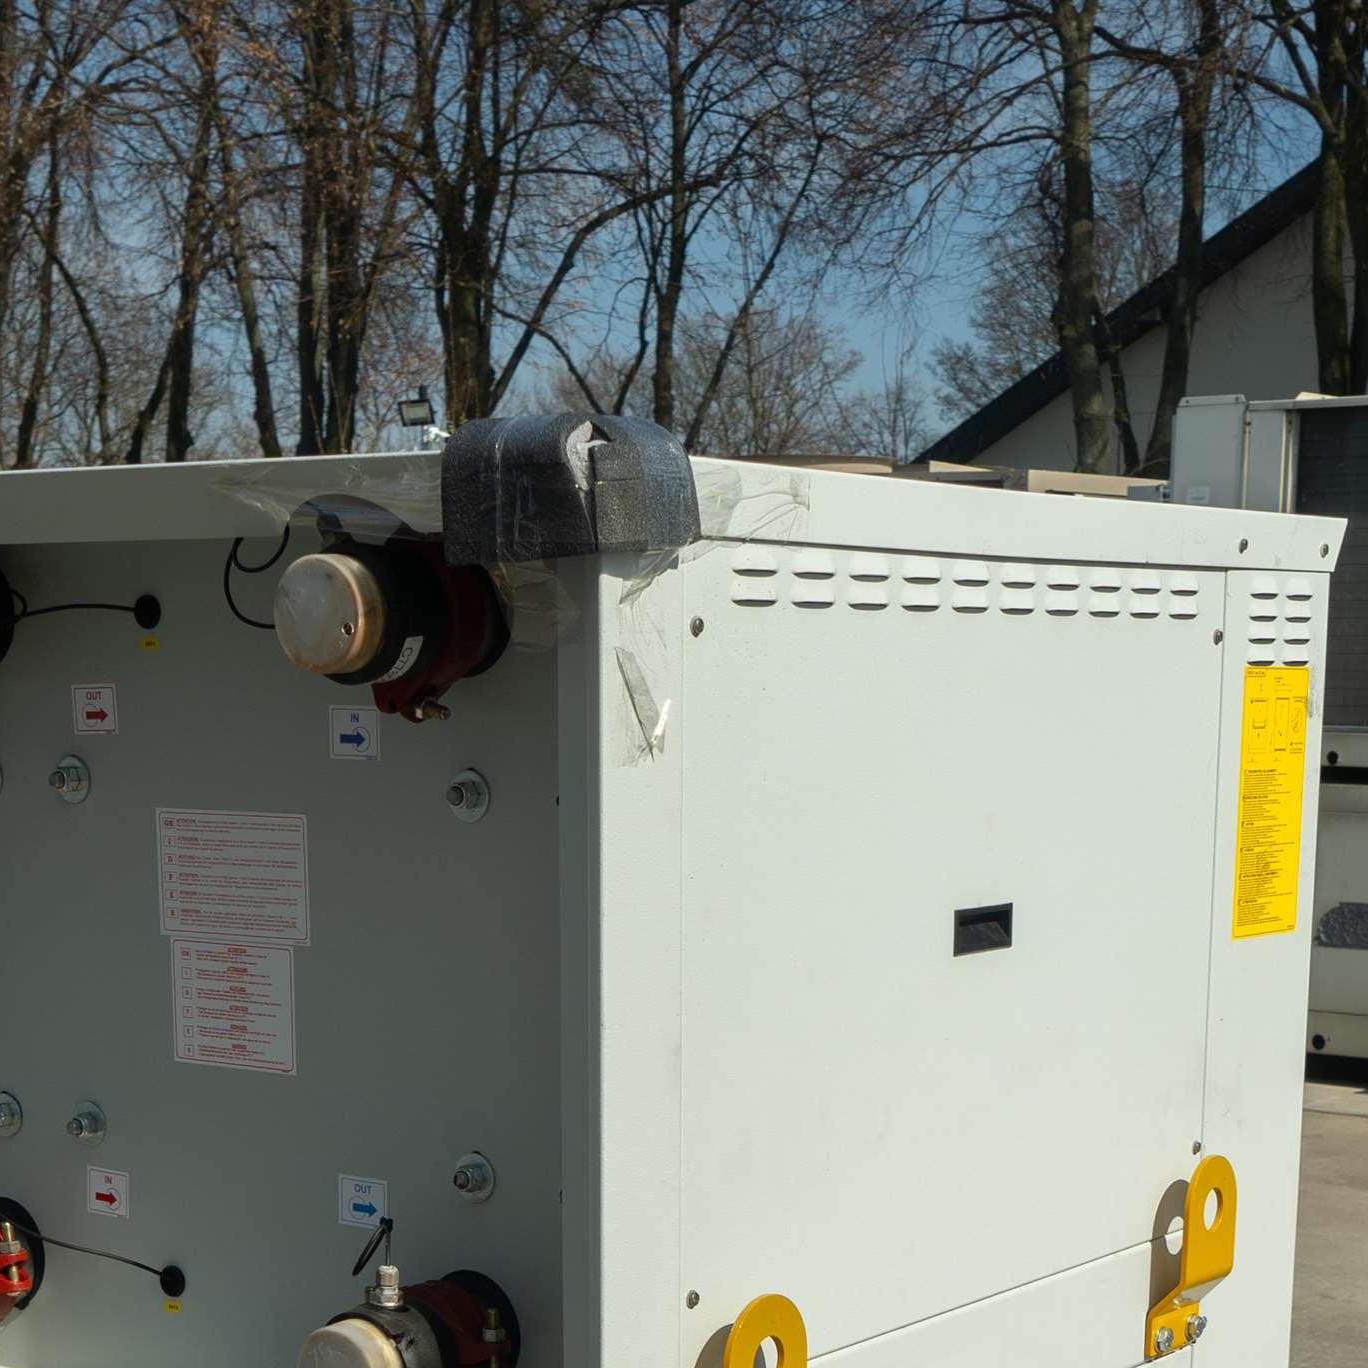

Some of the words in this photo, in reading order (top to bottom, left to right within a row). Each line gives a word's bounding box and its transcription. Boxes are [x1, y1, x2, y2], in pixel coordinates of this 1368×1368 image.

[86, 691, 102, 701] OUT
[350, 712, 360, 723] IN
[103, 1175, 113, 1185] IN
[354, 1183, 372, 1194] OUT
